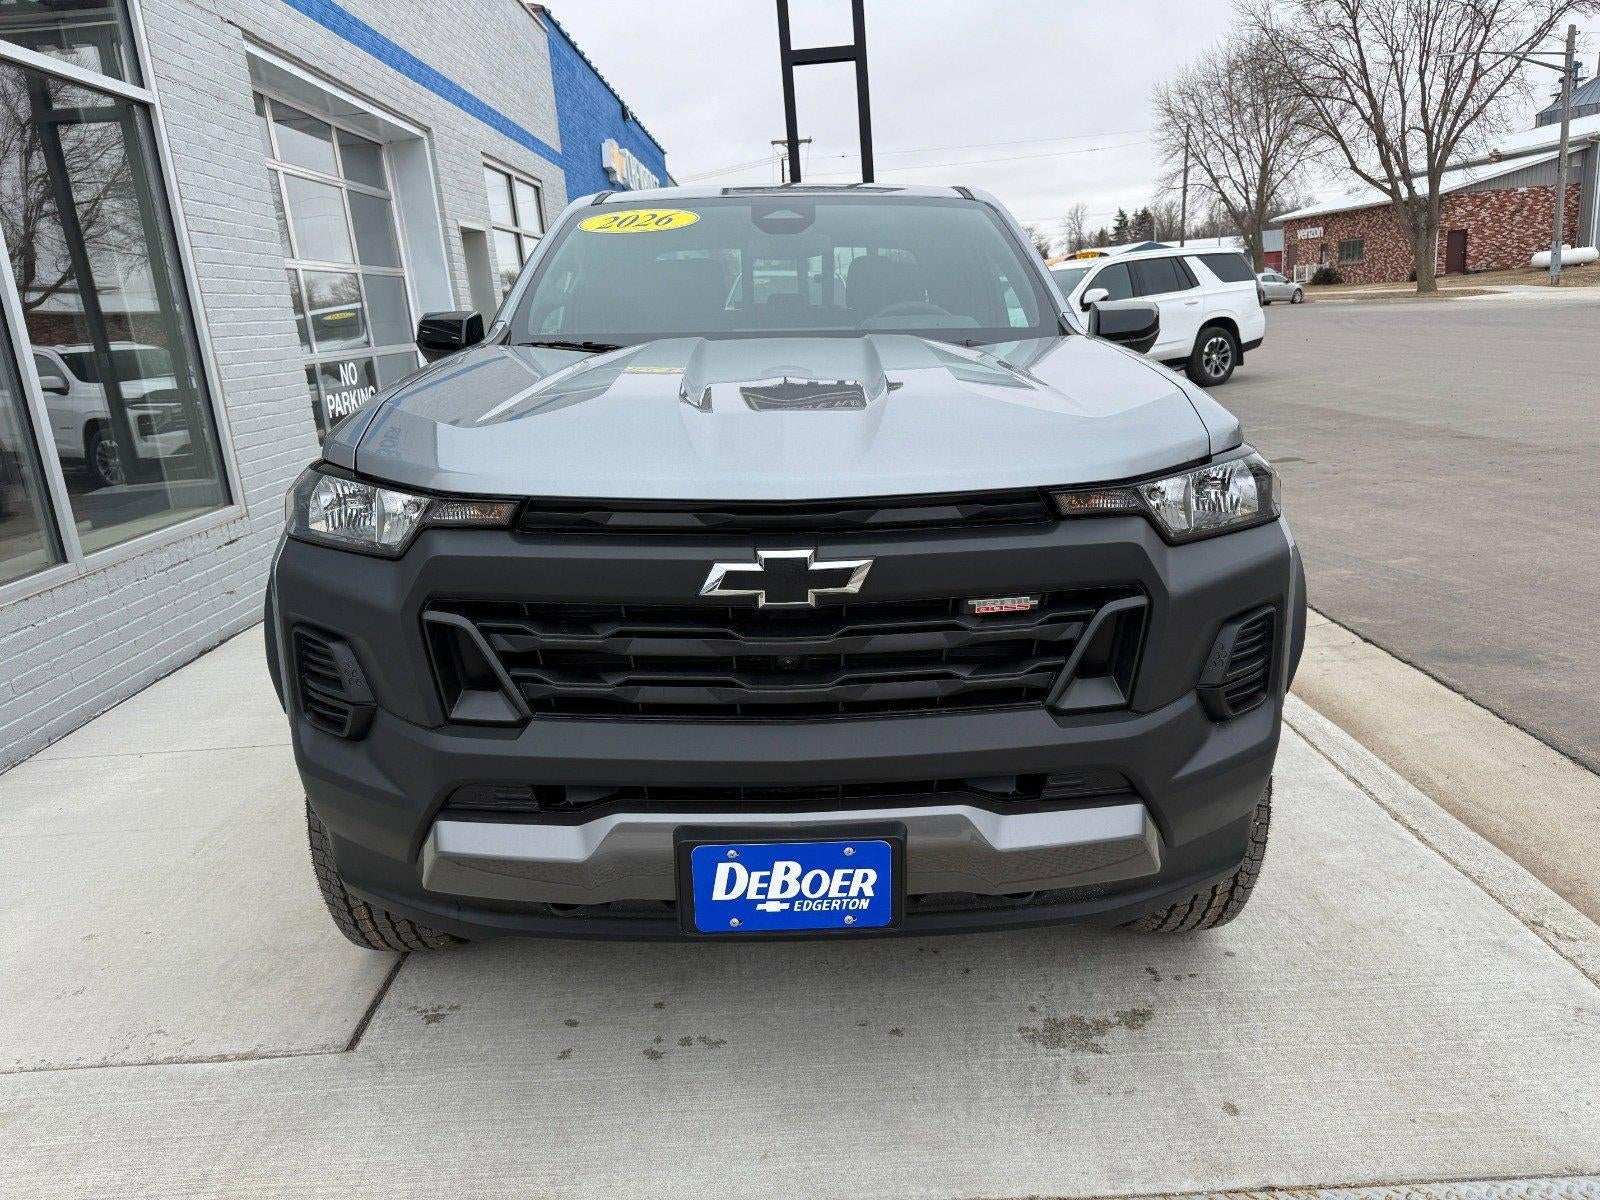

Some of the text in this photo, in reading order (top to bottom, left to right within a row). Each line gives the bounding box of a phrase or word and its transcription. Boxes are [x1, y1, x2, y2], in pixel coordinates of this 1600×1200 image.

[596, 213, 680, 230] 2026
[1297, 225, 1324, 240] verizon
[339, 362, 358, 387] NO
[793, 898, 871, 912] EDGERTON
